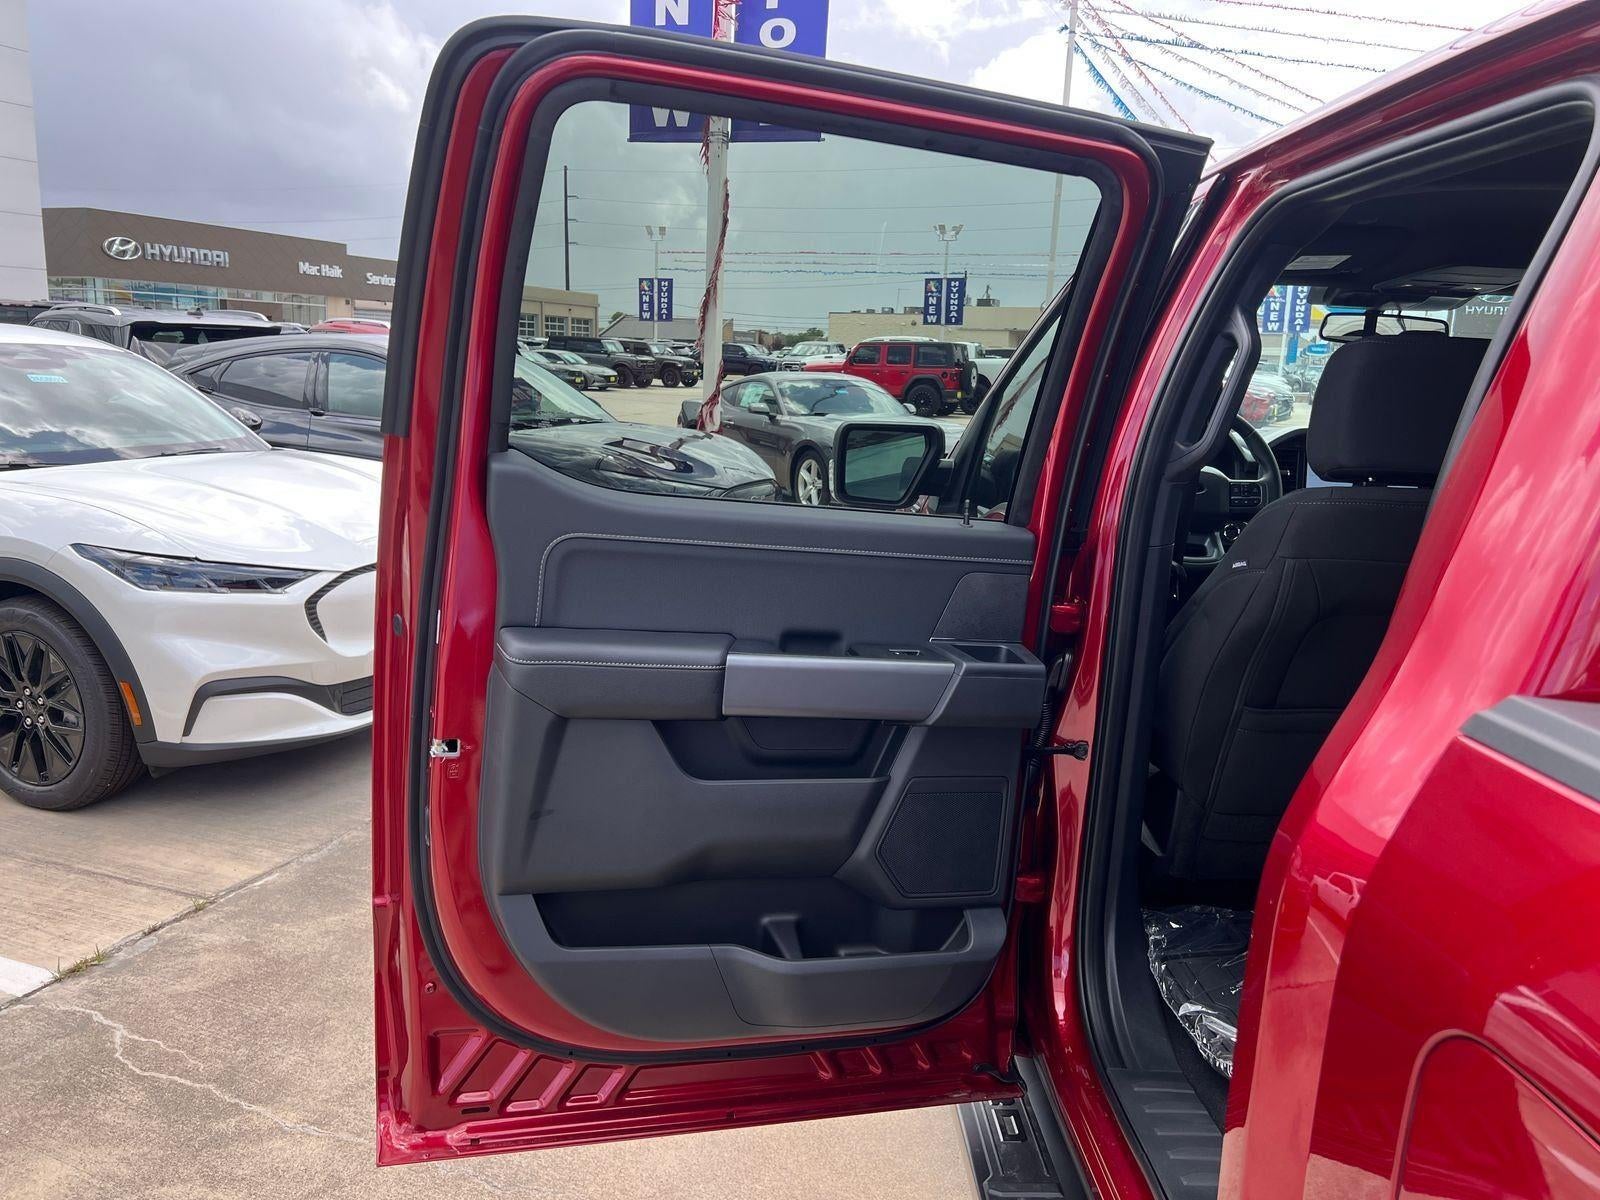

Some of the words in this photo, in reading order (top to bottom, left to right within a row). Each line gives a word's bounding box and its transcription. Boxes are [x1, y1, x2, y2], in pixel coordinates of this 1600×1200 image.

[144, 242, 229, 267] HYUNDAI
[298, 261, 320, 276] Mac
[320, 263, 343, 279] Haik
[642, 295, 650, 319] NEW
[927, 297, 937, 322] NEW
[950, 281, 959, 322] HYUNDAI
[1294, 286, 1307, 331] HYUNDAI
[1267, 302, 1280, 331] NEW
